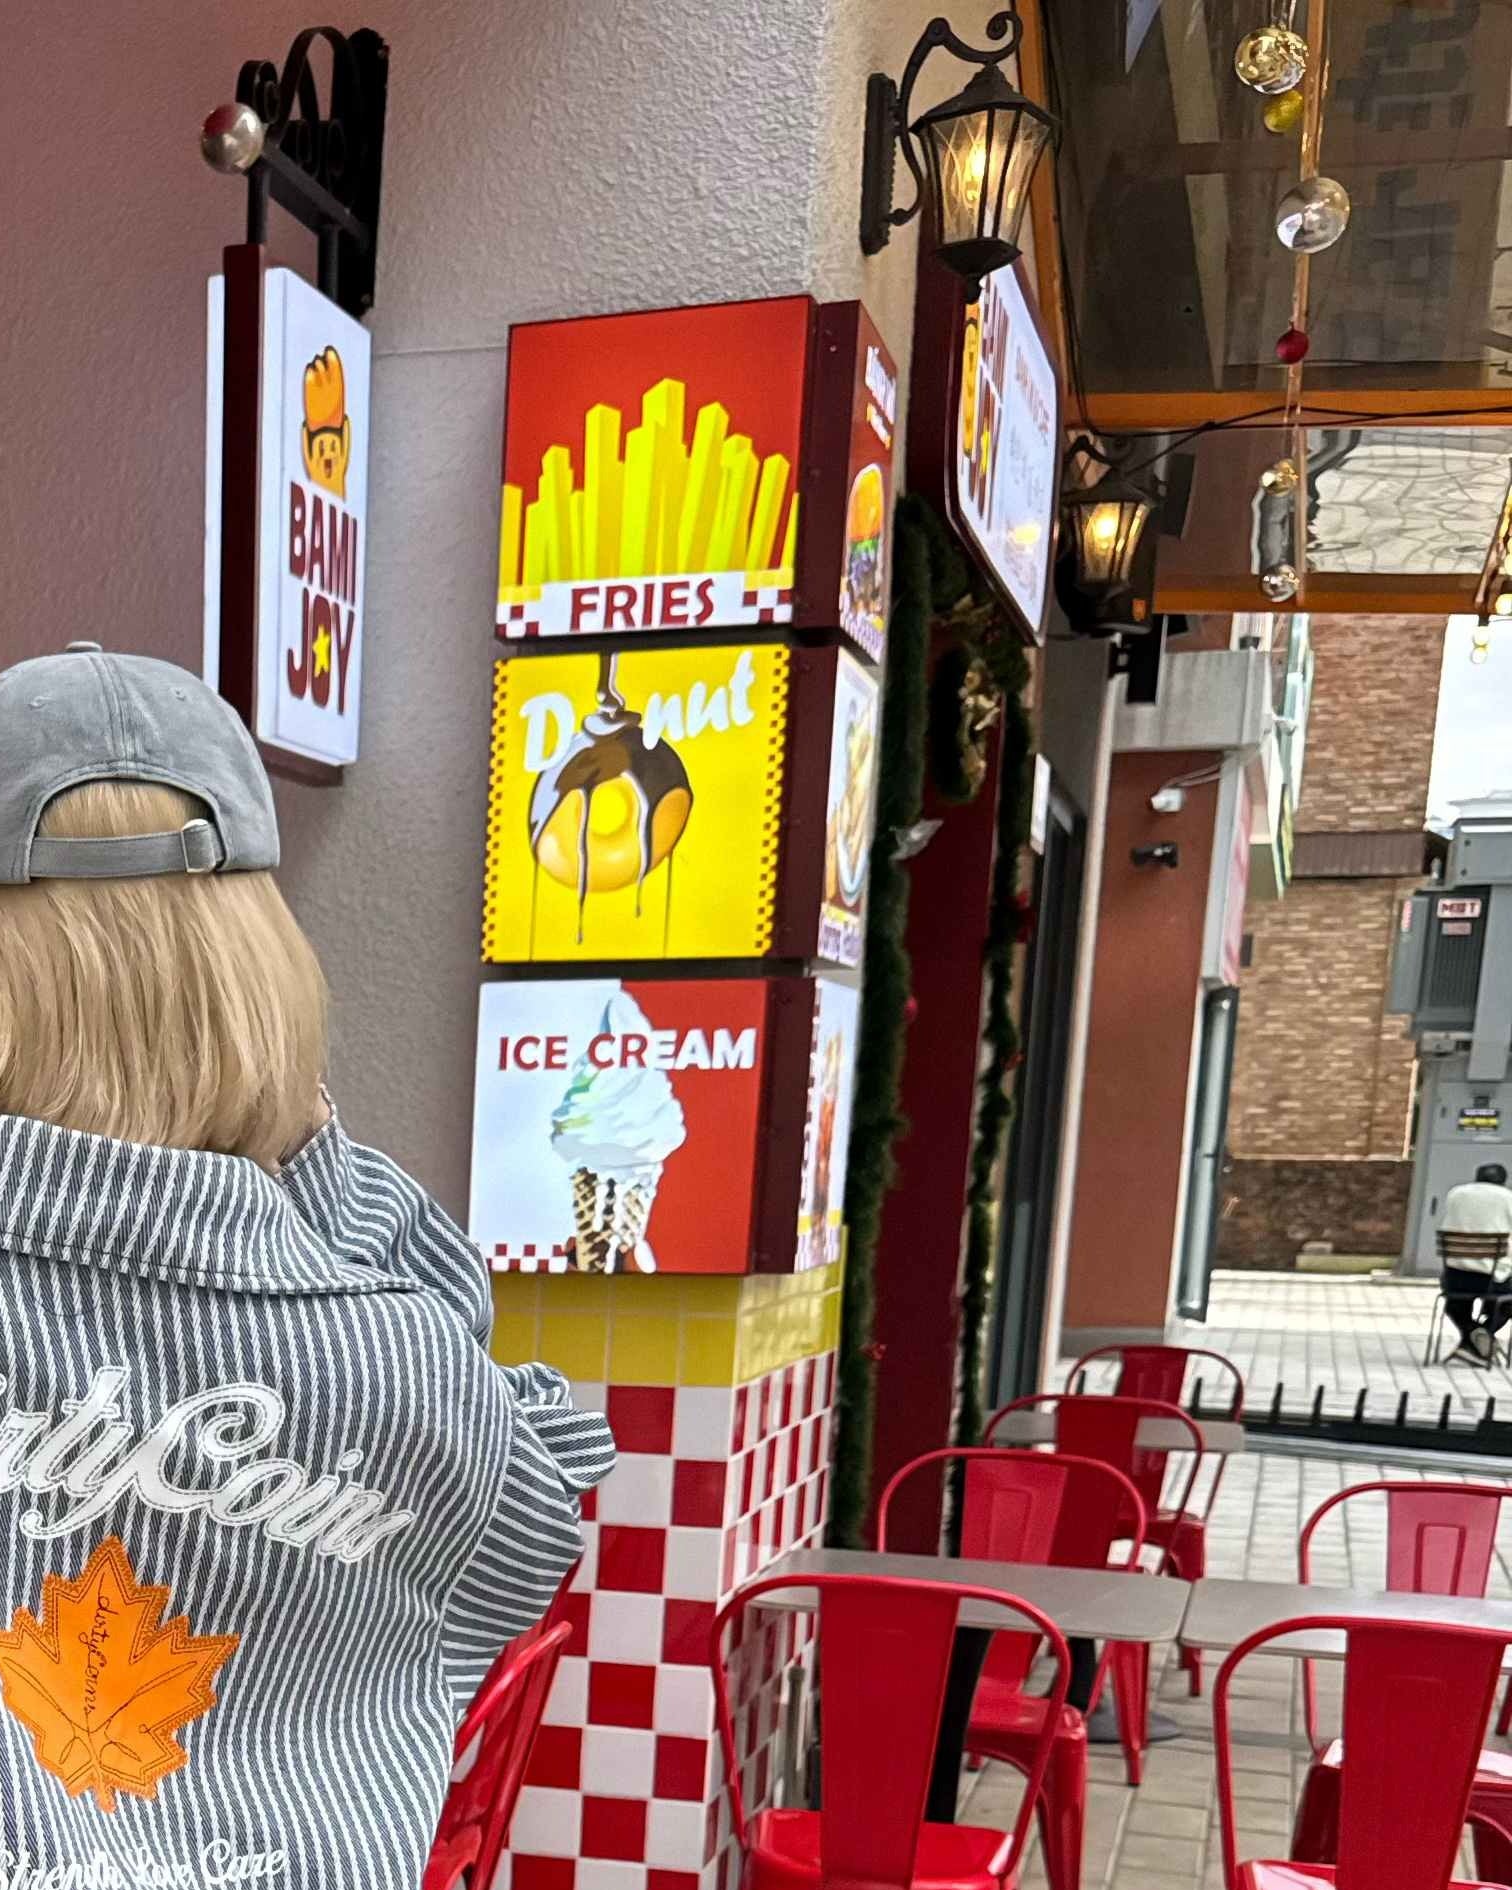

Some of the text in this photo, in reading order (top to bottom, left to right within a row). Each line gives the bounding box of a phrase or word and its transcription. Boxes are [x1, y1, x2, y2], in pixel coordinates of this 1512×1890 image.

[289, 480, 358, 607] BAMI
[570, 578, 715, 633] FRIES
[287, 587, 355, 717] JOY
[498, 1027, 758, 1071] ICE CREAM
[199, 1838, 287, 1884] Care
